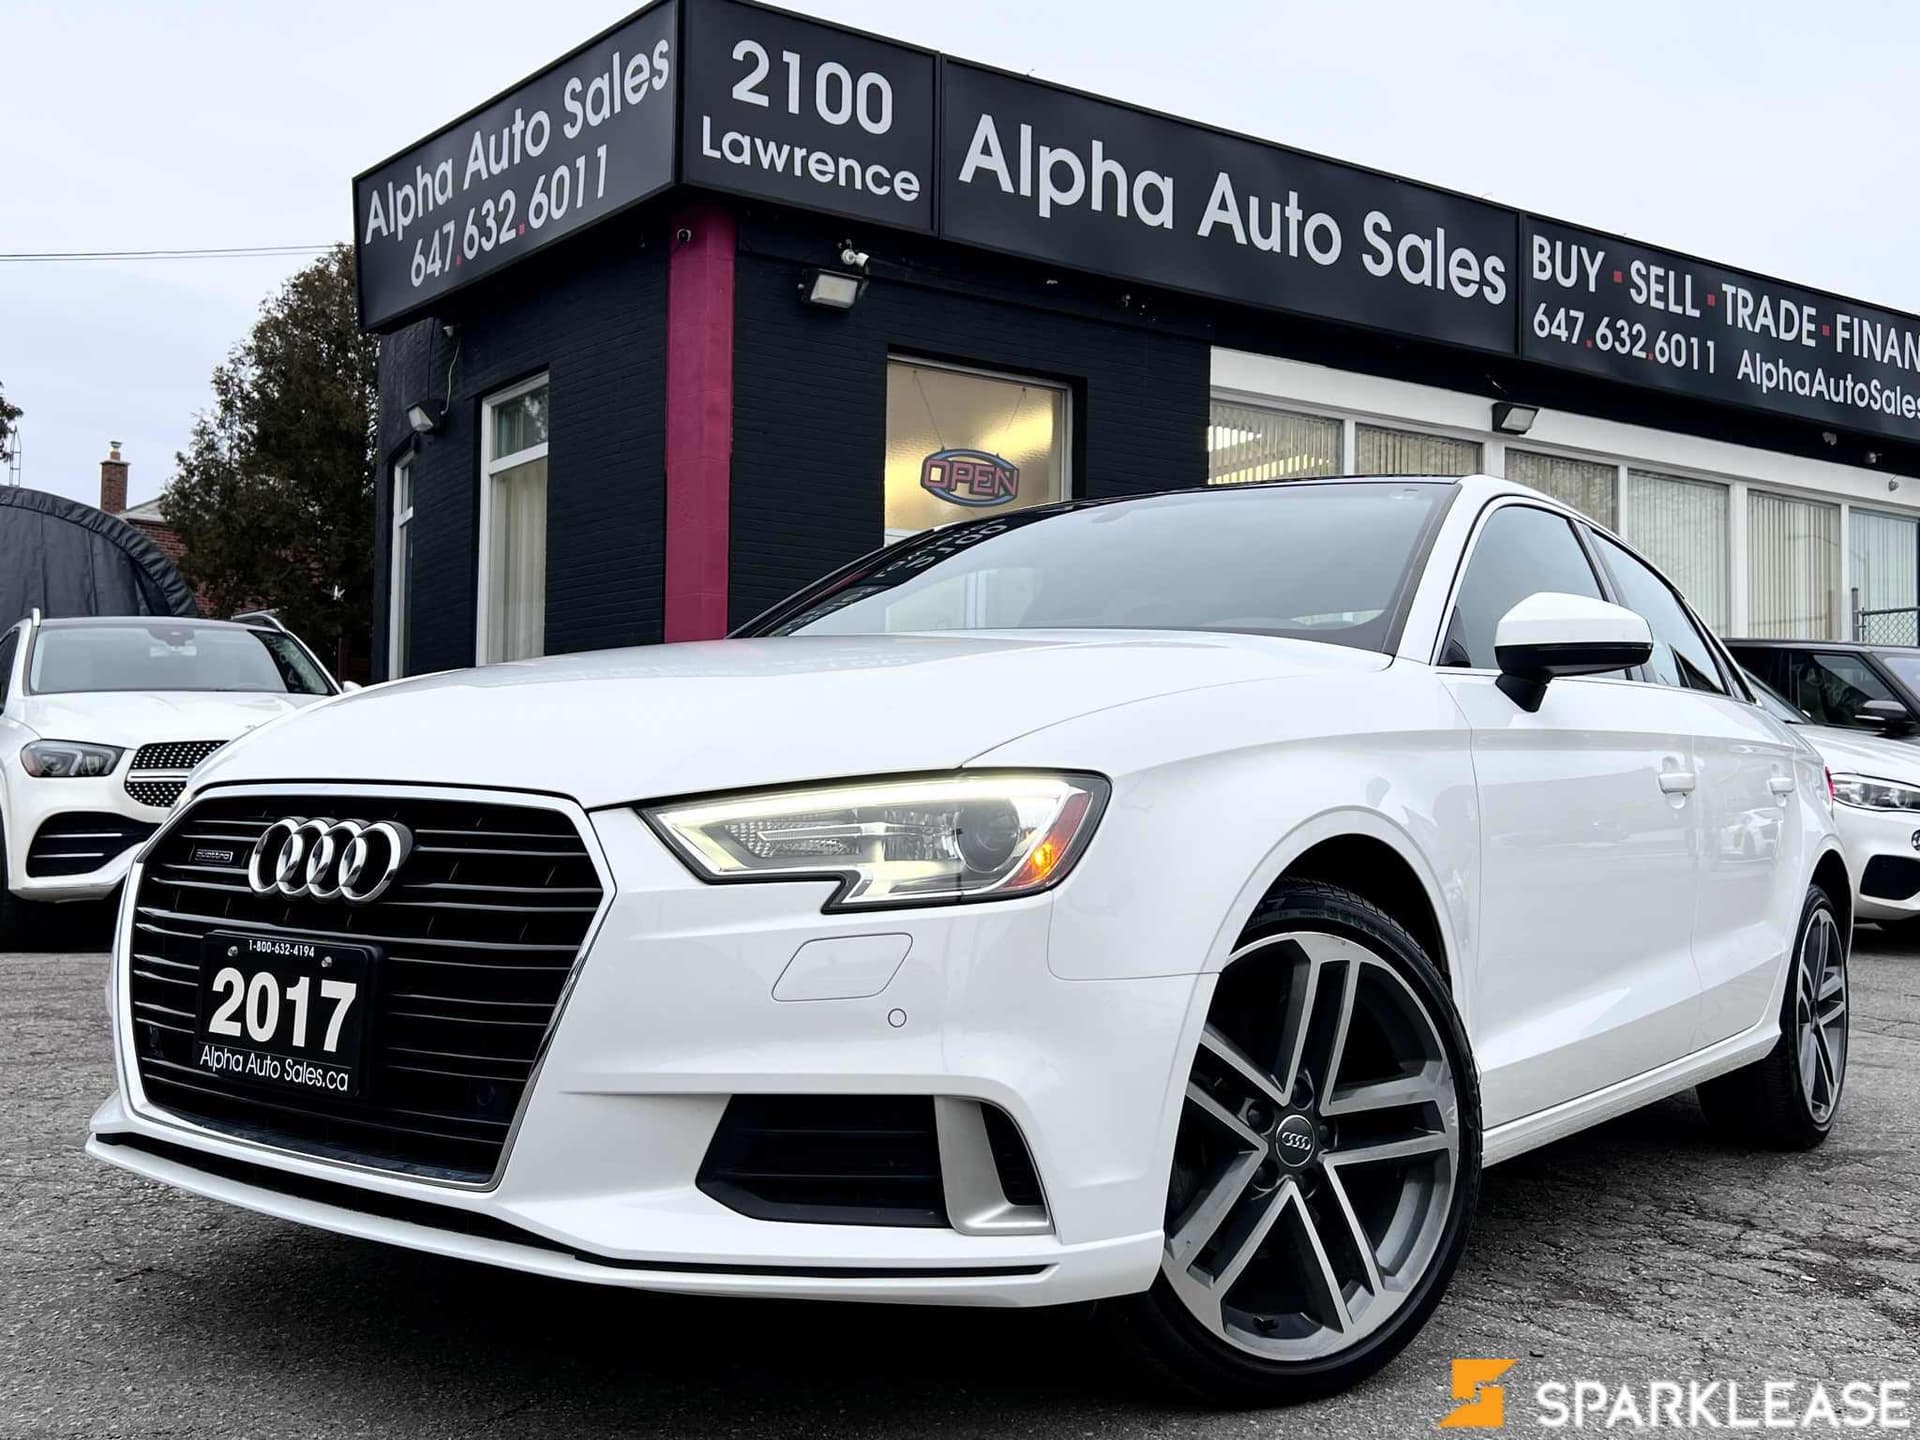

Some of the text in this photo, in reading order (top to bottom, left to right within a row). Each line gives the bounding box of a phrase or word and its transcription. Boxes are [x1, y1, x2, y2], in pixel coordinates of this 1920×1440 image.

[731, 39, 893, 135] 2100
[364, 38, 670, 245] Alpha Auto Sales
[702, 115, 921, 202] Lawrence
[410, 144, 608, 288] 647.632.6011
[958, 113, 1507, 305] Alpha Auto Sales
[1532, 234, 1606, 293] BUY
[1629, 259, 1701, 318] SELL
[1721, 282, 1817, 348] TRADE
[1533, 302, 1716, 374] 647.632.6011
[923, 459, 1020, 497] OPEN
[248, 939, 315, 958] 1-800-632-4194
[208, 967, 357, 1053] 2017
[199, 1044, 349, 1092] Alpha Auto Sales.ca
